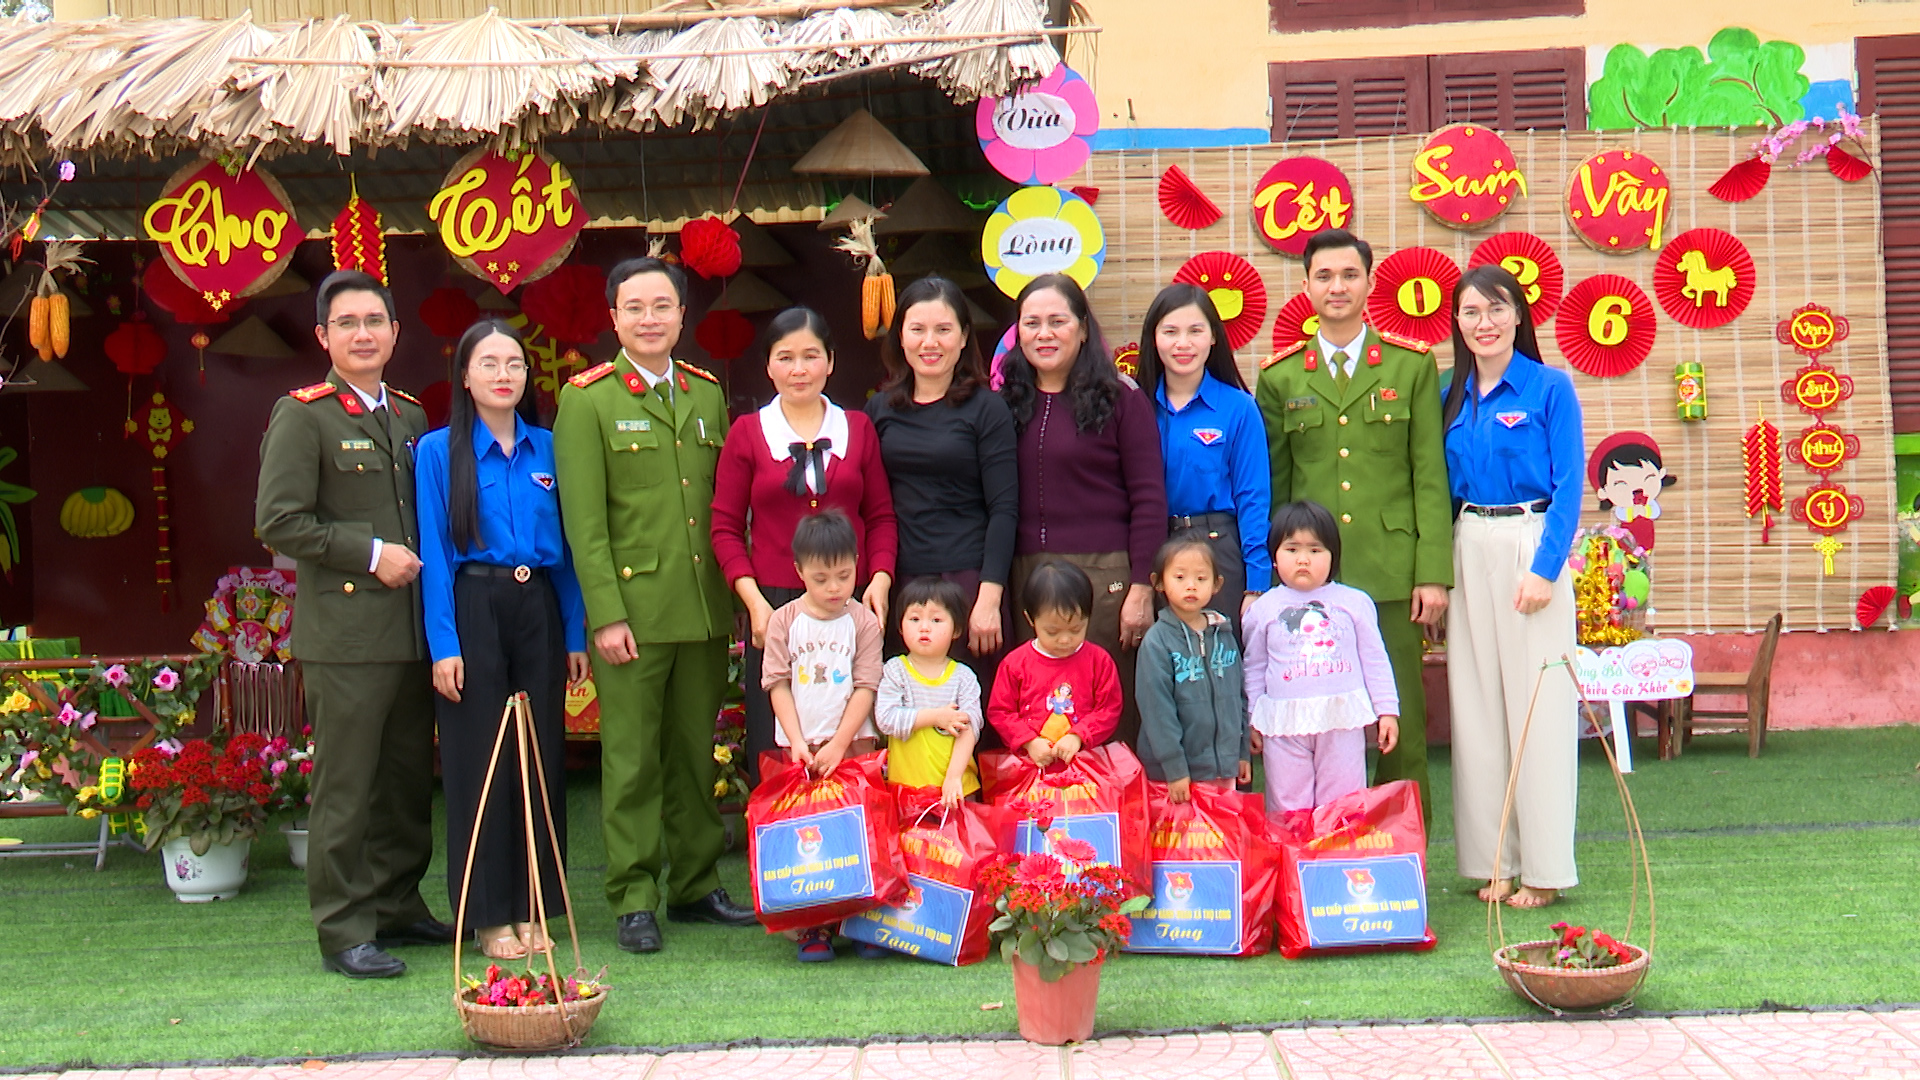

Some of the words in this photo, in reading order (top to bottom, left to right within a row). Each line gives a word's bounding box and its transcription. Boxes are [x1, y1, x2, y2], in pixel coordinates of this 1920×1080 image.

[143, 179, 289, 267] Chợ
[429, 153, 575, 257] Tết
[1001, 234, 1074, 256] Lòng
[1254, 180, 1350, 239] Tết
[1409, 144, 1528, 202] Sum
[1579, 163, 1668, 250] Vầy
